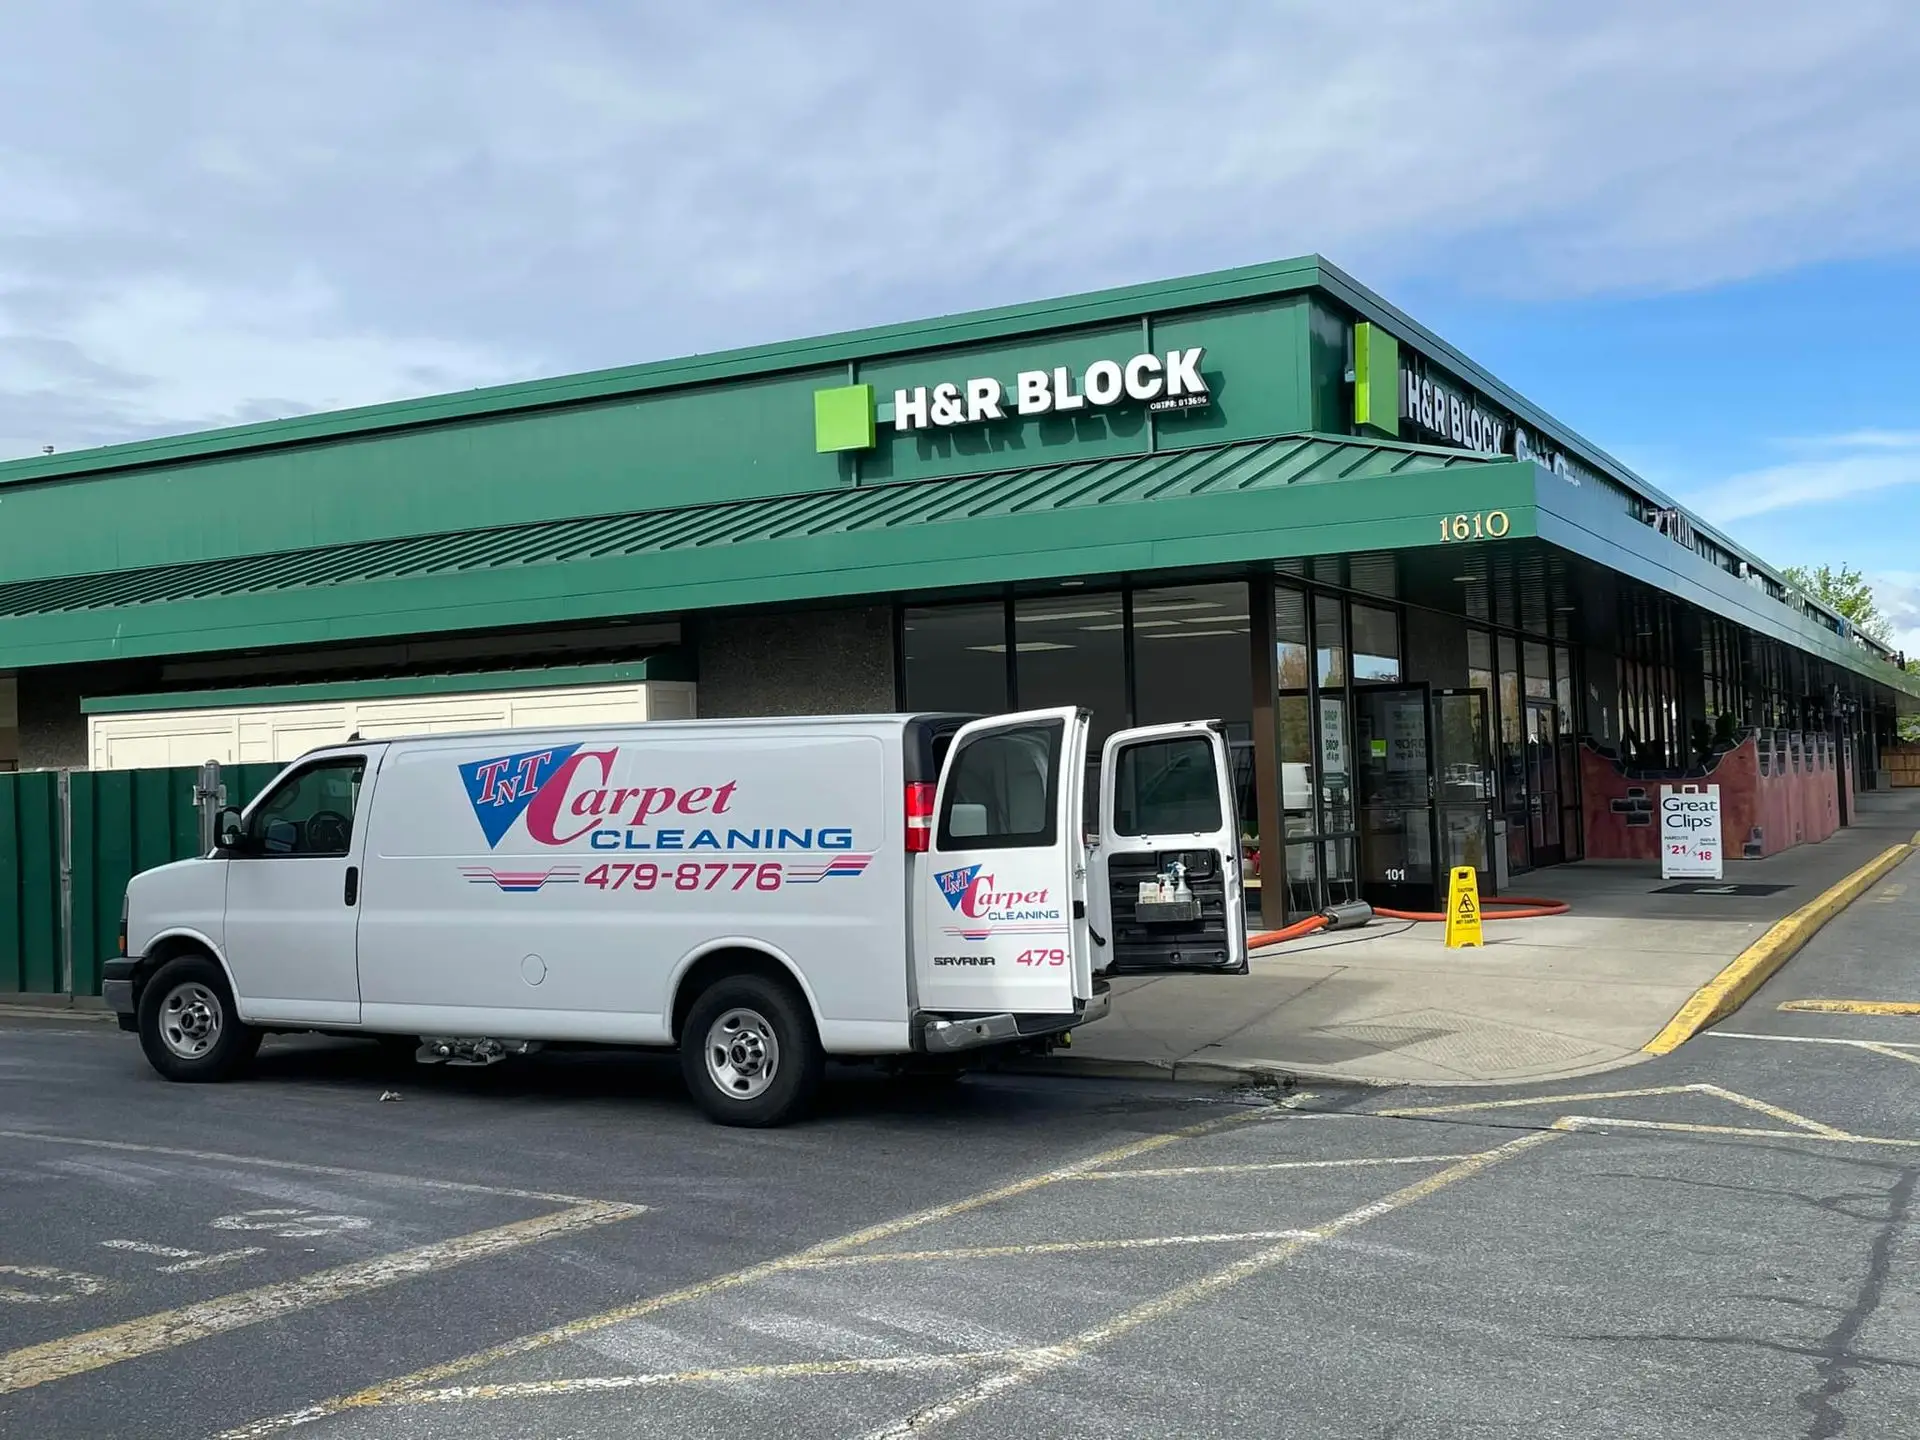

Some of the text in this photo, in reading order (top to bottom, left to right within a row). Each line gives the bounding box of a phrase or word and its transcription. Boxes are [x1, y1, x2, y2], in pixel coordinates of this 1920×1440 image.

[894, 346, 1208, 432] H&R BLOCK
[1406, 369, 1503, 455] H&R BLOCK
[1439, 511, 1511, 543] 1610
[475, 750, 551, 807] TNT
[526, 746, 737, 846] Carpet
[1662, 797, 1718, 812] Great
[1666, 813, 1713, 832] Clips
[590, 828, 853, 850] CLEANING
[584, 863, 783, 891] 479-8776
[941, 867, 972, 895] TNT
[1385, 869, 1405, 881] 101
[960, 873, 1049, 919] Carpet
[988, 909, 1060, 921] CLEANING
[934, 956, 996, 966] SAVANA
[1016, 949, 1065, 967] 479
